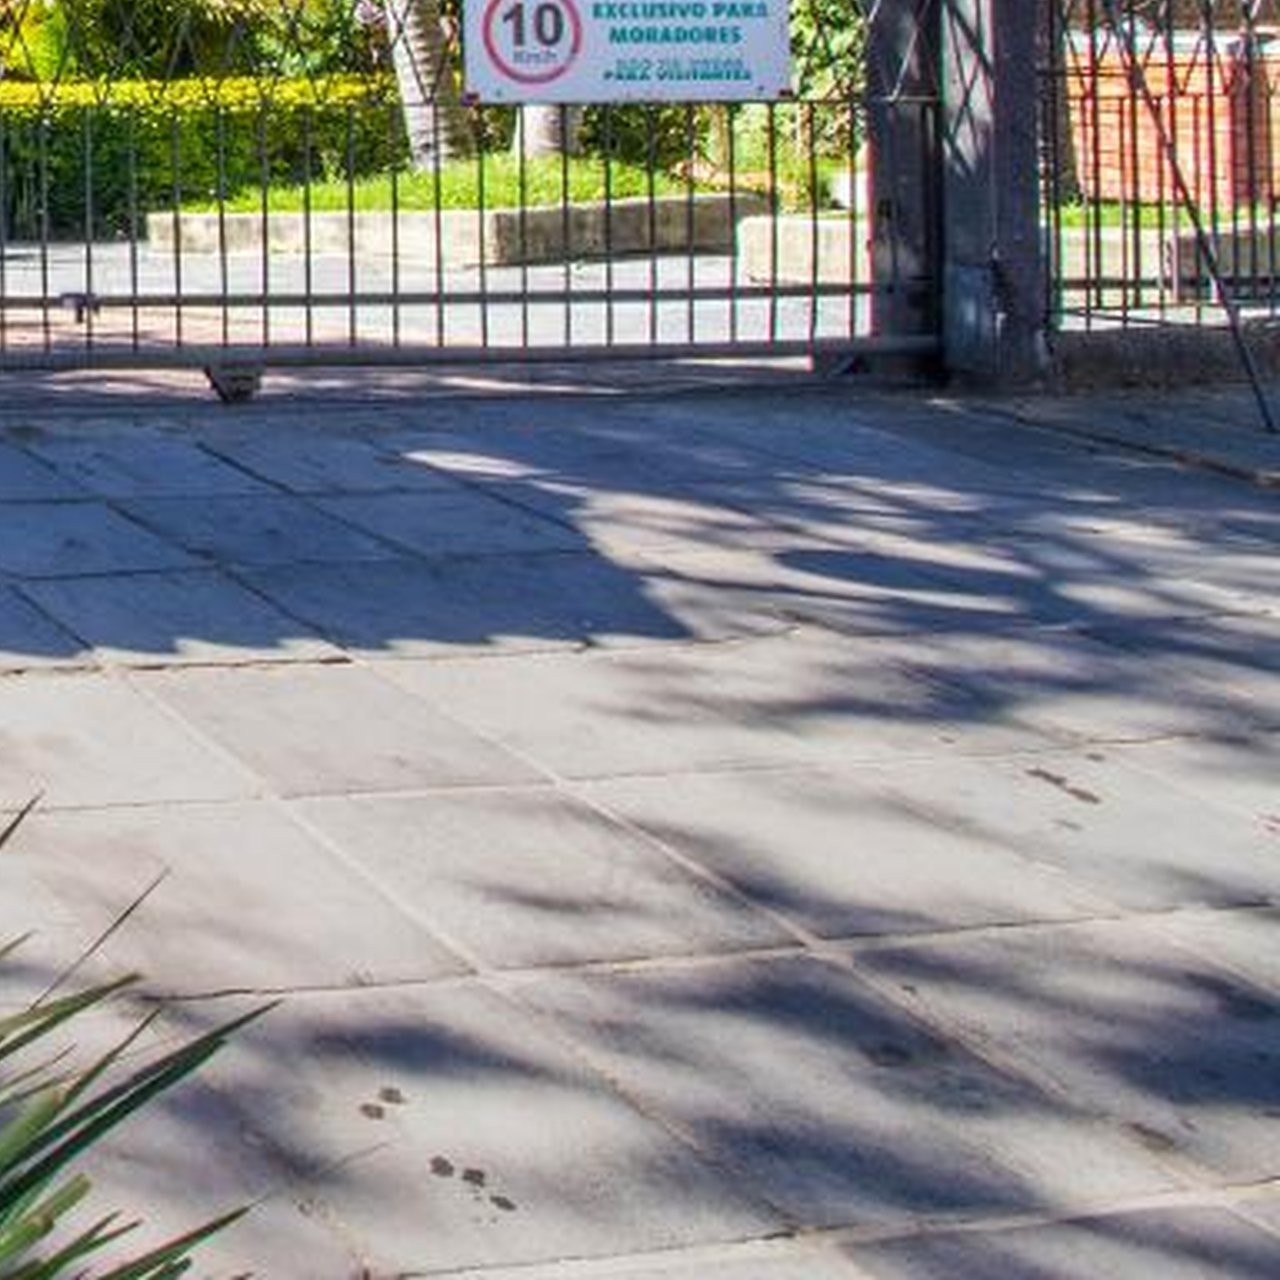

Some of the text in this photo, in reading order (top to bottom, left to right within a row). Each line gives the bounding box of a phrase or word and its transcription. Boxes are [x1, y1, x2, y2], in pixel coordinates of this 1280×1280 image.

[592, 2, 769, 19] EXCLUSIVO PARA
[502, 1, 564, 47] 10
[608, 25, 744, 44] MORADORES
